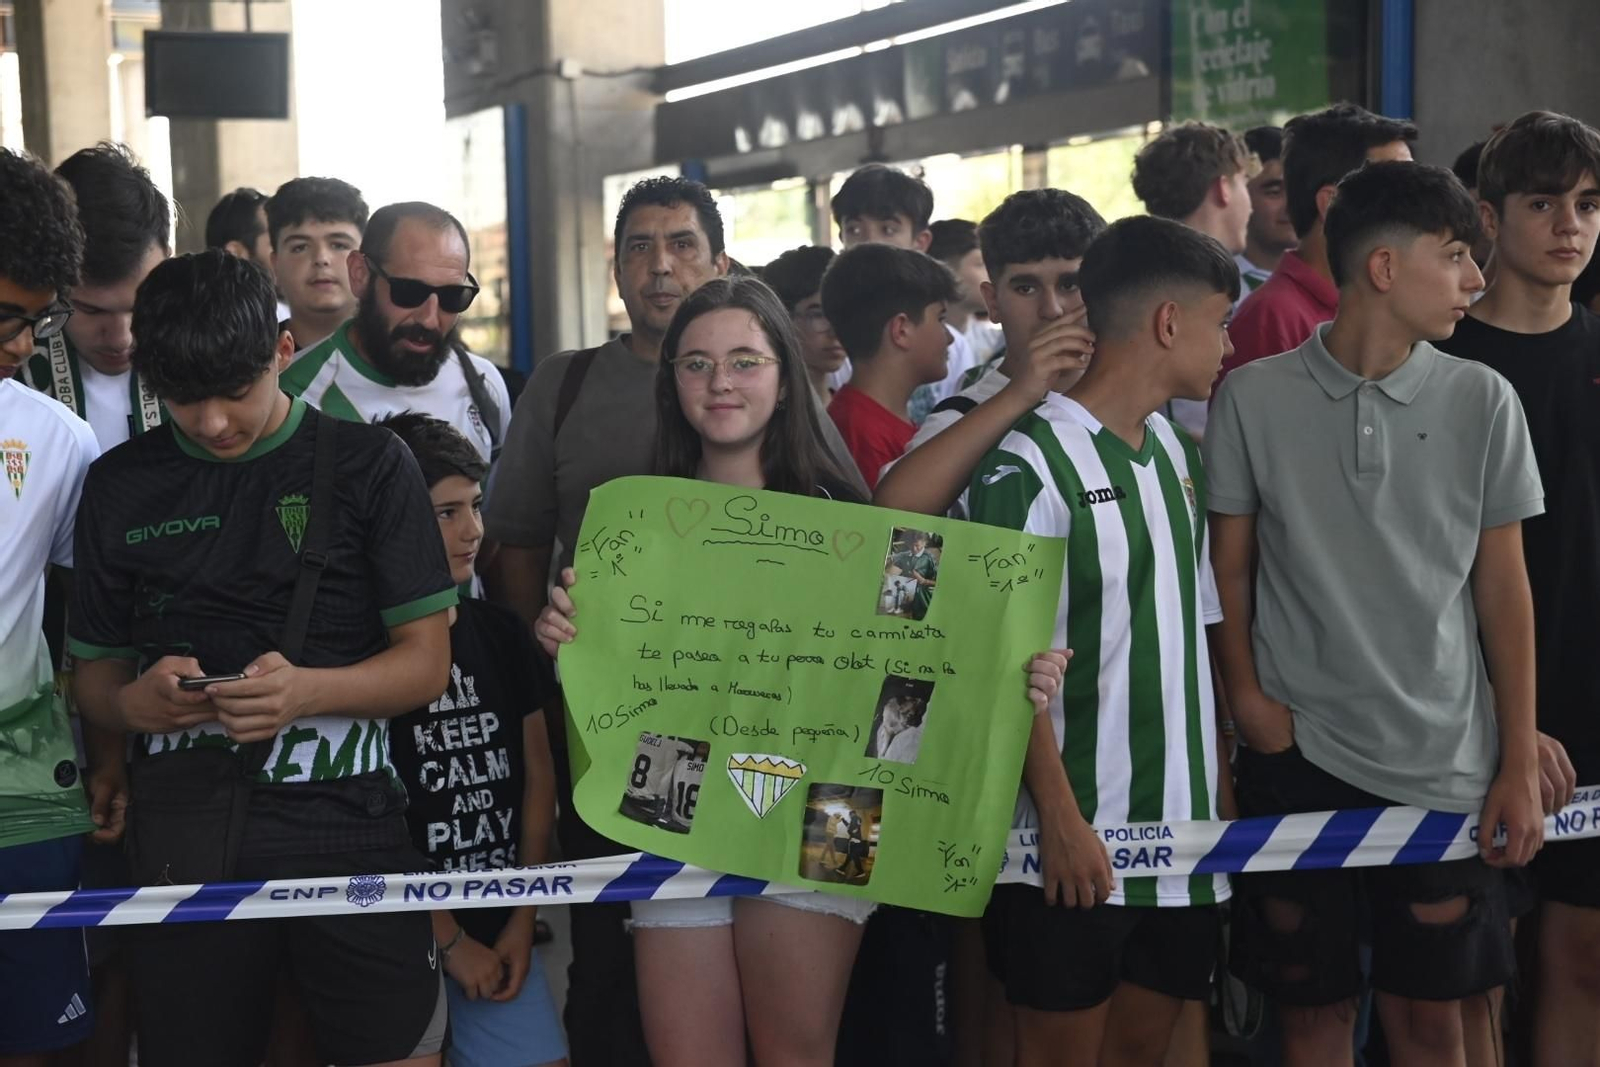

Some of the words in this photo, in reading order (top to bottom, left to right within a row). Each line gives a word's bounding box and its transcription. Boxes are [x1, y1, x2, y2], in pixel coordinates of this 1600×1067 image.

[52, 340, 67, 374] CLUB
[125, 515, 221, 545] GIVOVA
[620, 594, 664, 624] Si
[680, 614, 716, 628] me
[723, 618, 793, 640] regalas
[812, 621, 836, 638] tu
[850, 624, 946, 640] camiseta
[637, 642, 662, 660] te
[738, 653, 750, 665] a
[759, 647, 781, 664] tu
[632, 673, 653, 692] has
[710, 684, 720, 693] a
[412, 711, 500, 756] KEEP
[418, 747, 512, 793] CALM
[630, 753, 652, 789] 8
[687, 761, 705, 773] SIMO
[451, 788, 494, 815] AND
[426, 807, 514, 853] PLAY
[1104, 825, 1174, 843] POLICIA
[1554, 809, 1587, 836] NO
[1112, 846, 1174, 870] SAR
[269, 886, 339, 901] CNP
[403, 882, 452, 903] NO
[462, 875, 574, 900] PASAR
